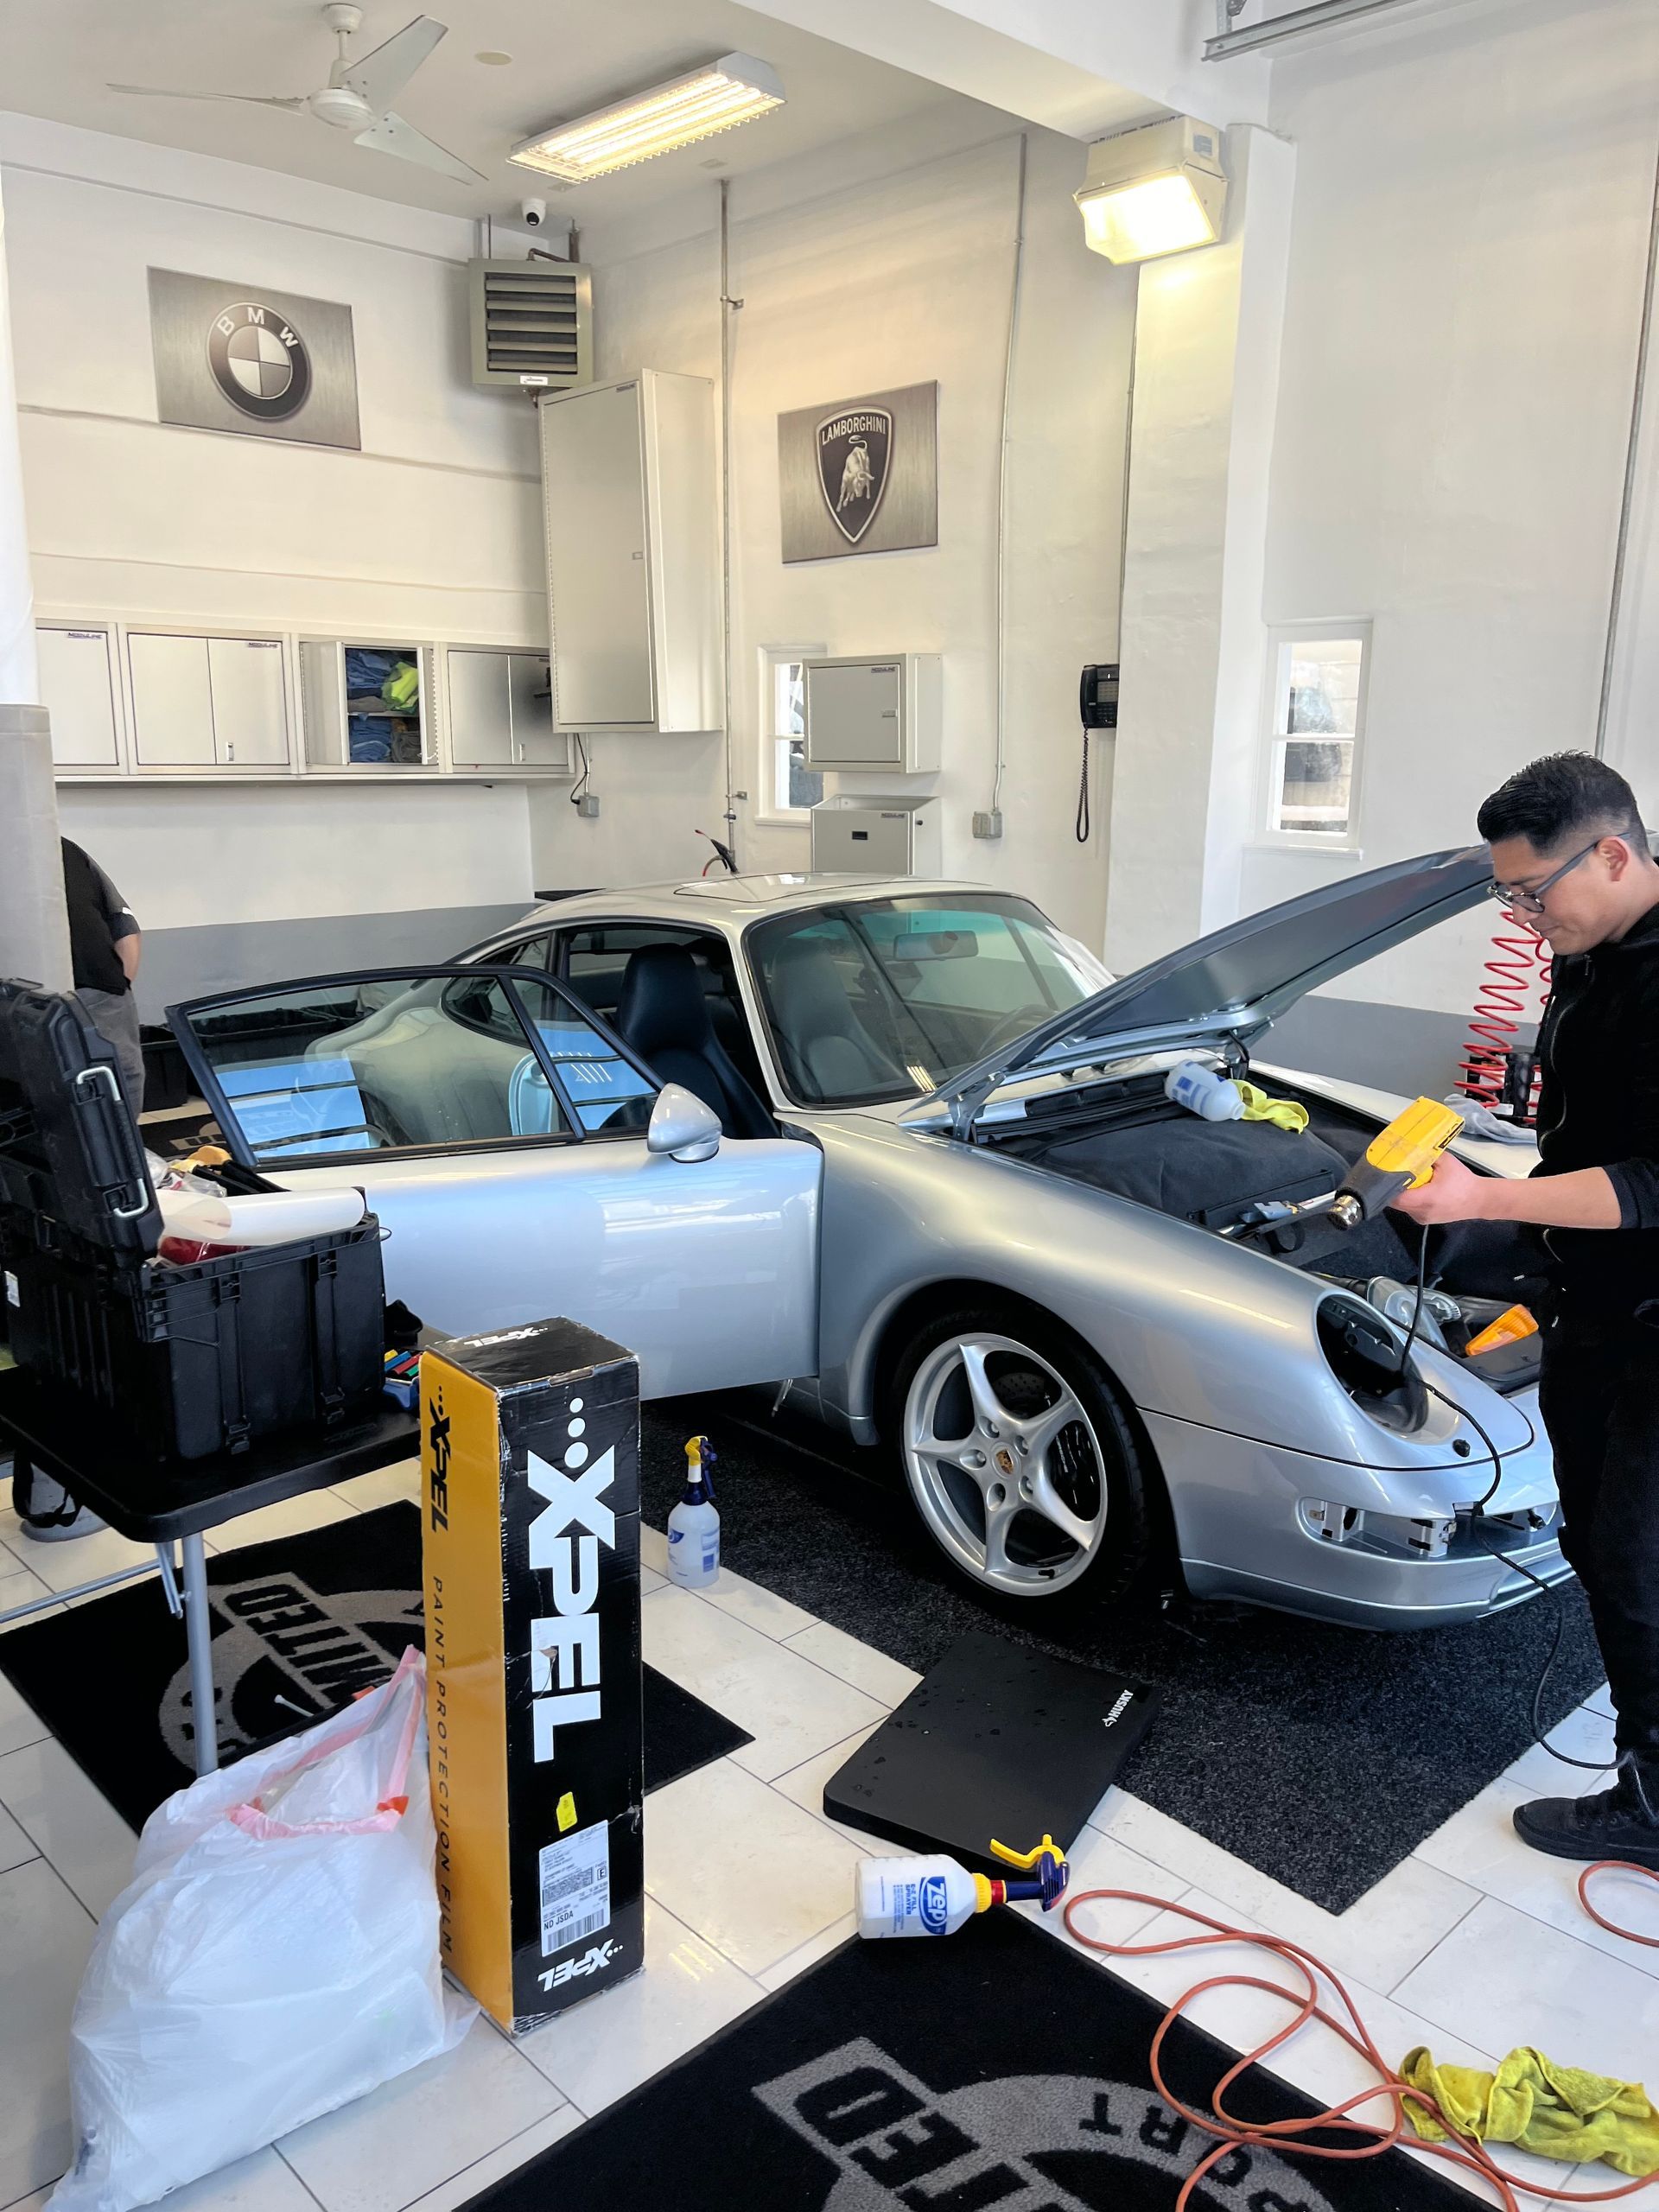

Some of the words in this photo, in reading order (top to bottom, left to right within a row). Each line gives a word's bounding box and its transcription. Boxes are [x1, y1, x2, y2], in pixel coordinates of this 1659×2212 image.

[216, 307, 299, 347] BMW
[822, 416, 886, 446] LAMBORGHINI
[463, 1326, 541, 1348] XPEL
[429, 1397, 451, 1534] XPEL
[433, 1575, 446, 1669] PAINT
[527, 1445, 615, 1764] XPEL
[1108, 1689, 1134, 1719] HUSKY
[435, 1680, 449, 1872] PROTECTION
[440, 1885, 453, 1953] FILM
[543, 1919, 554, 1931] ND
[556, 1910, 574, 1926] JSDA
[537, 1938, 613, 1993] XPEL
